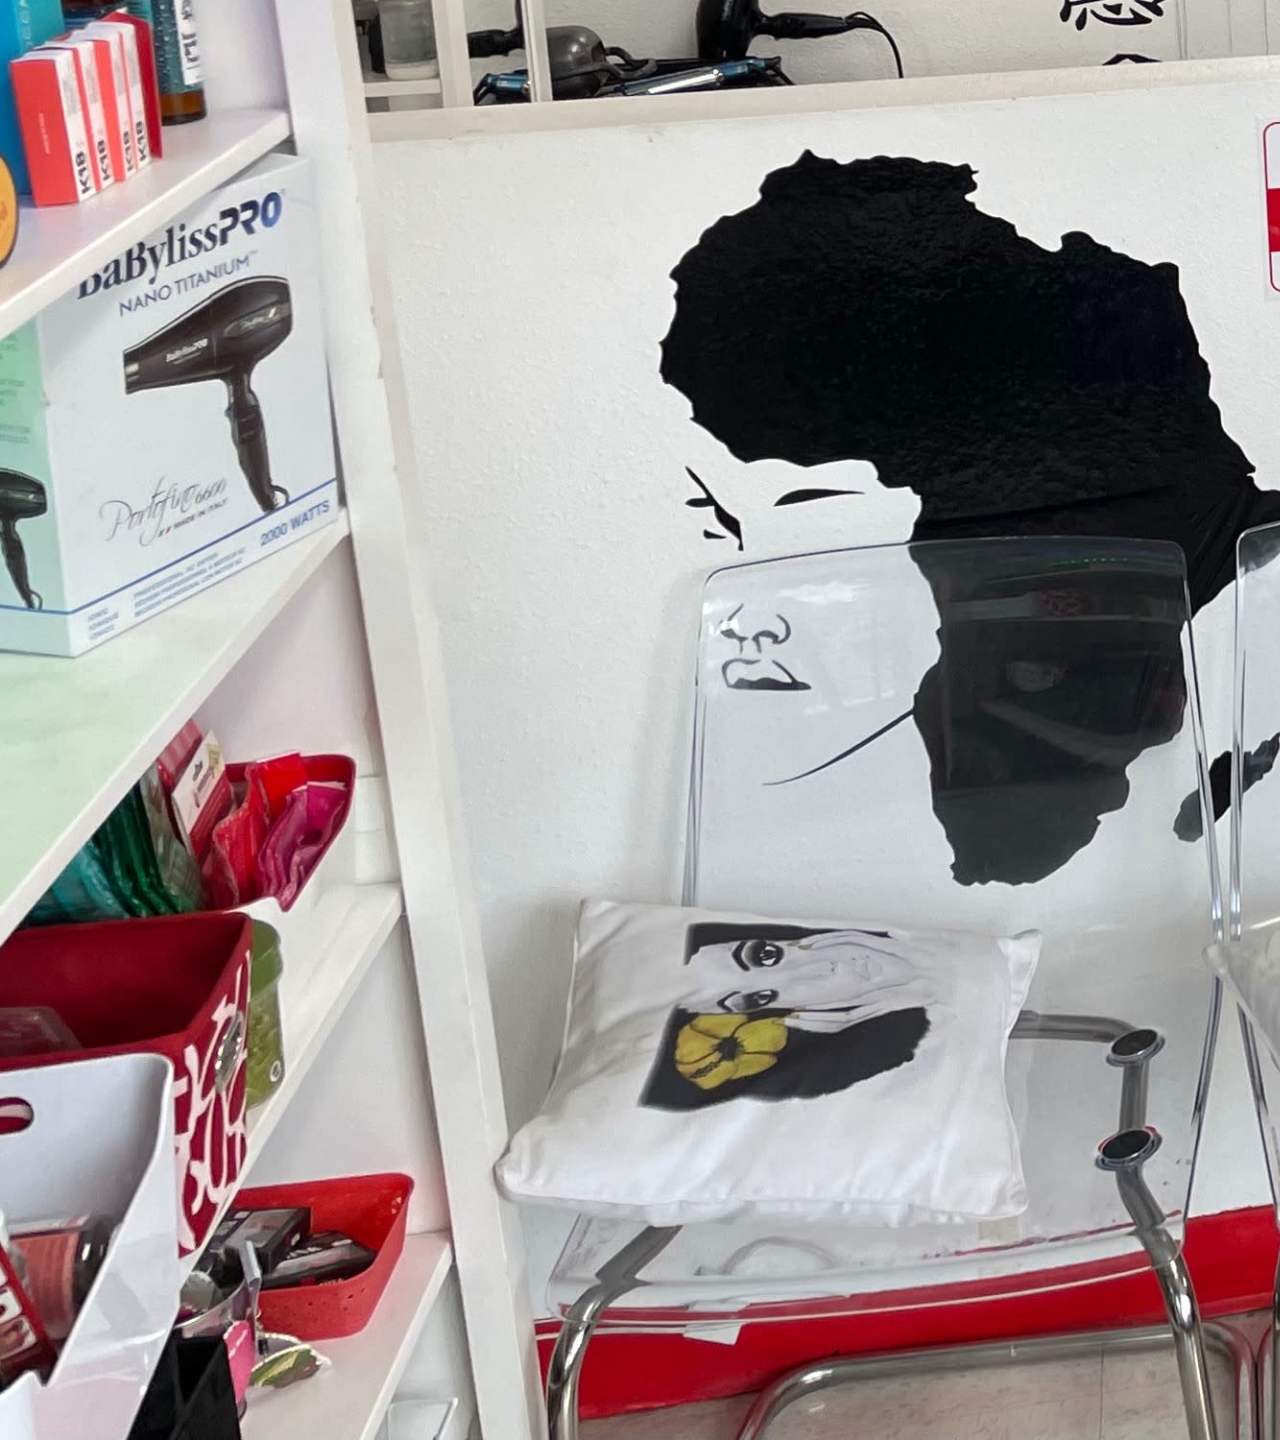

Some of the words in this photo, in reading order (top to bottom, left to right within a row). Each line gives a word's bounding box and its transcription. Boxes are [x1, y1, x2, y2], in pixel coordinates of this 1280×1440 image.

[97, 139, 111, 181] K18
[122, 131, 134, 172] K18
[135, 120, 147, 162] K18
[75, 151, 91, 194] K18
[120, 284, 172, 318] NANO
[99, 474, 200, 548] Portofino
[260, 522, 289, 547] 2000
[289, 500, 331, 531] WATTS
